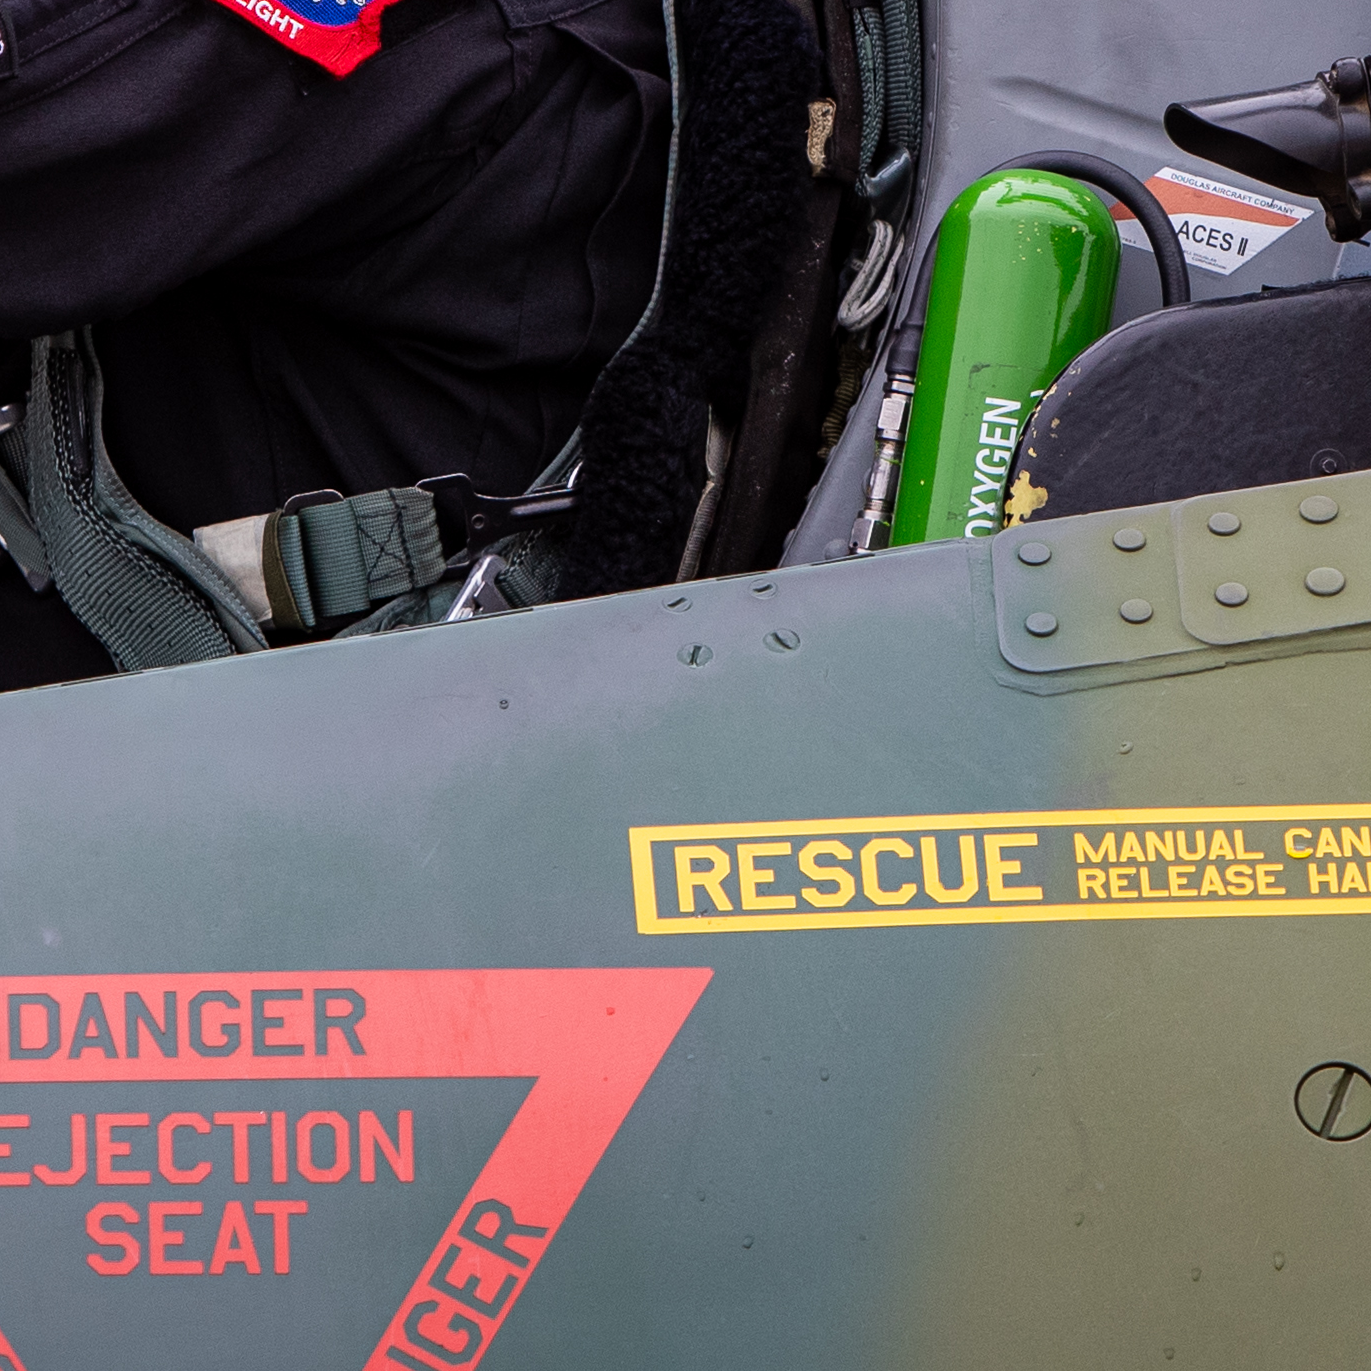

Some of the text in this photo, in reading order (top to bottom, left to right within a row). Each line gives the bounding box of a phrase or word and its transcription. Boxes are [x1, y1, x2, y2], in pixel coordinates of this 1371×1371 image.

[1170, 172, 1296, 215] DOUGLAS AIRCRAFT COMPANY
[1176, 220, 1249, 257] ACES II
[674, 832, 1044, 913] RESCUE
[1073, 829, 1265, 864] MANUAL
[1077, 863, 1287, 900] RELEASE
[7, 988, 368, 1060] DANGER
[85, 1200, 309, 1276] SEAT
[385, 1198, 550, 1371] GER
